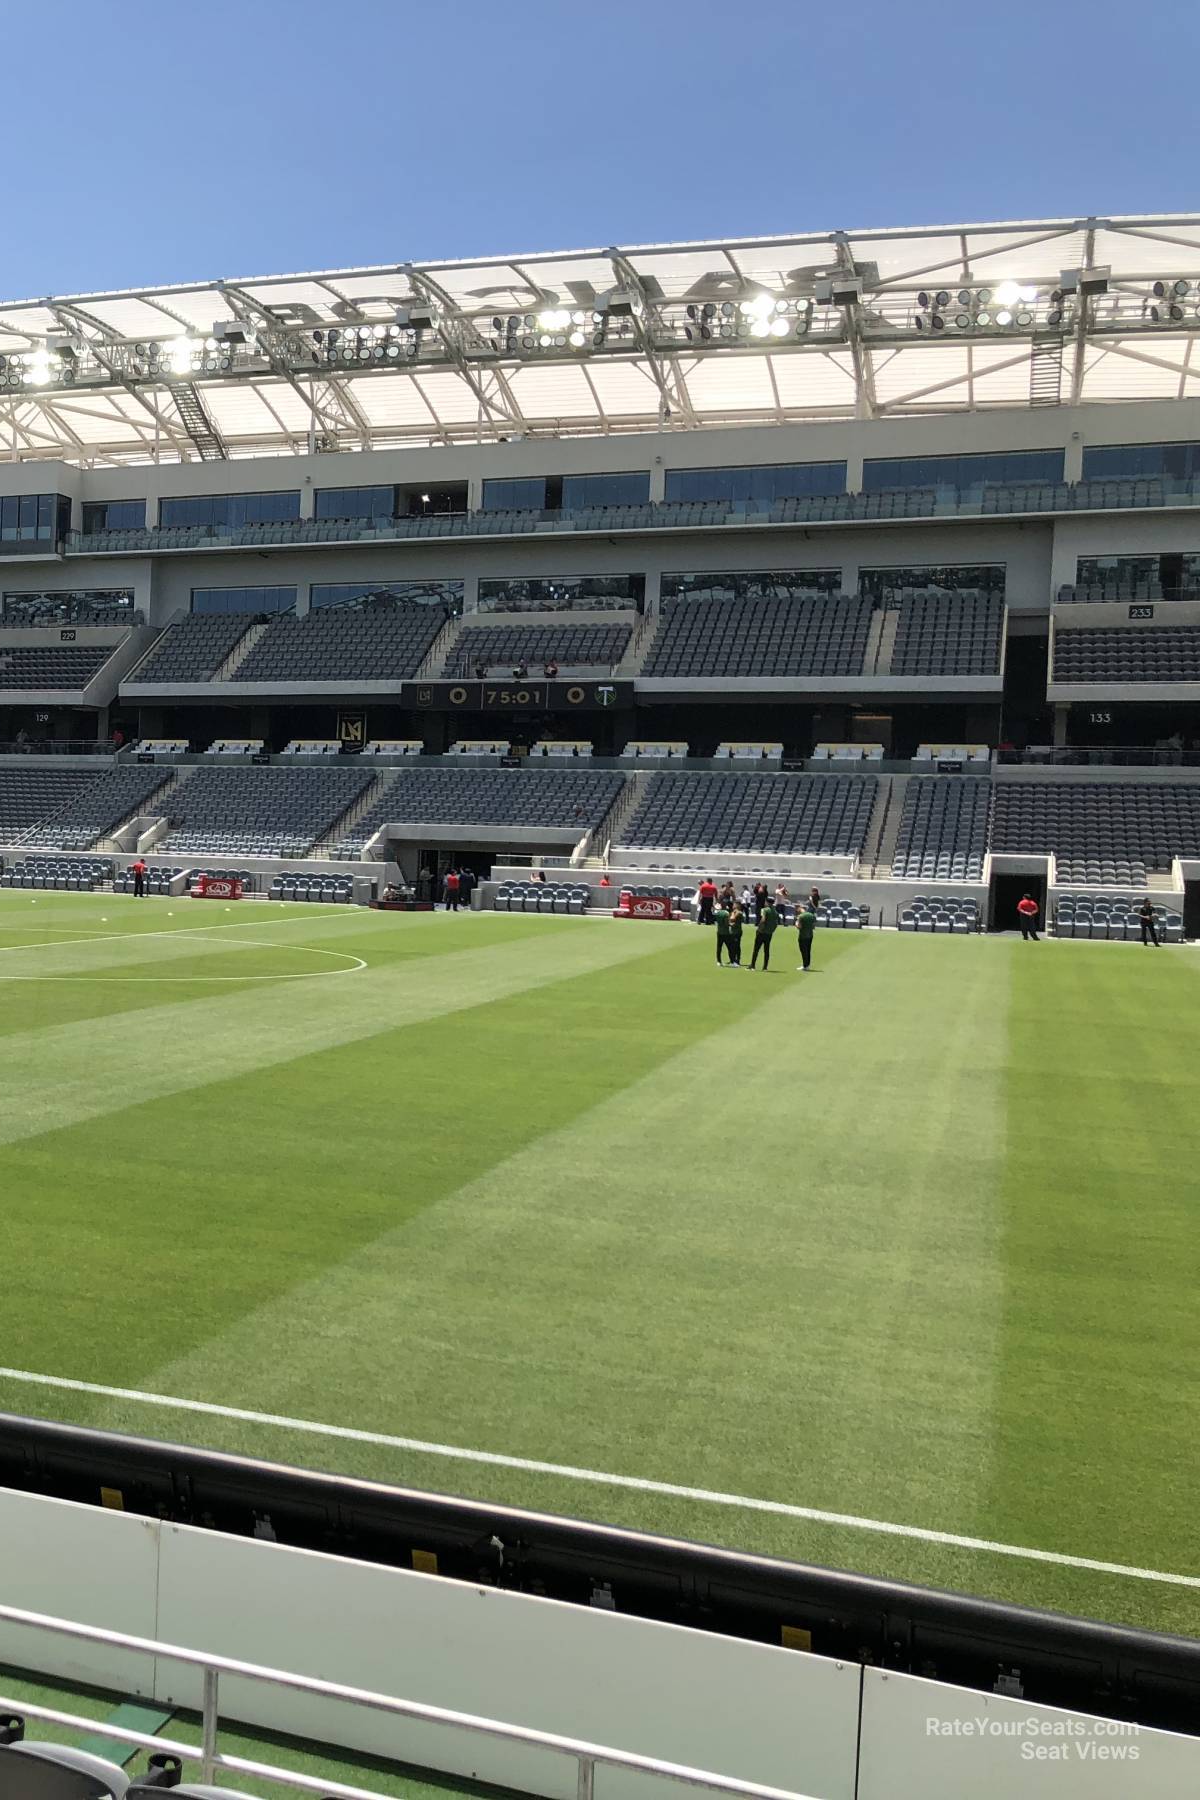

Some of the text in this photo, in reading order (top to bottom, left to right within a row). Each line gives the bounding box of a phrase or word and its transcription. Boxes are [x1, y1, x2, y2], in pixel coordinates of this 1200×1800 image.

[1131, 608, 1151, 618] 233
[62, 632, 75, 640] 229
[487, 691, 540, 704] 75:01
[1090, 713, 1111, 723] 133
